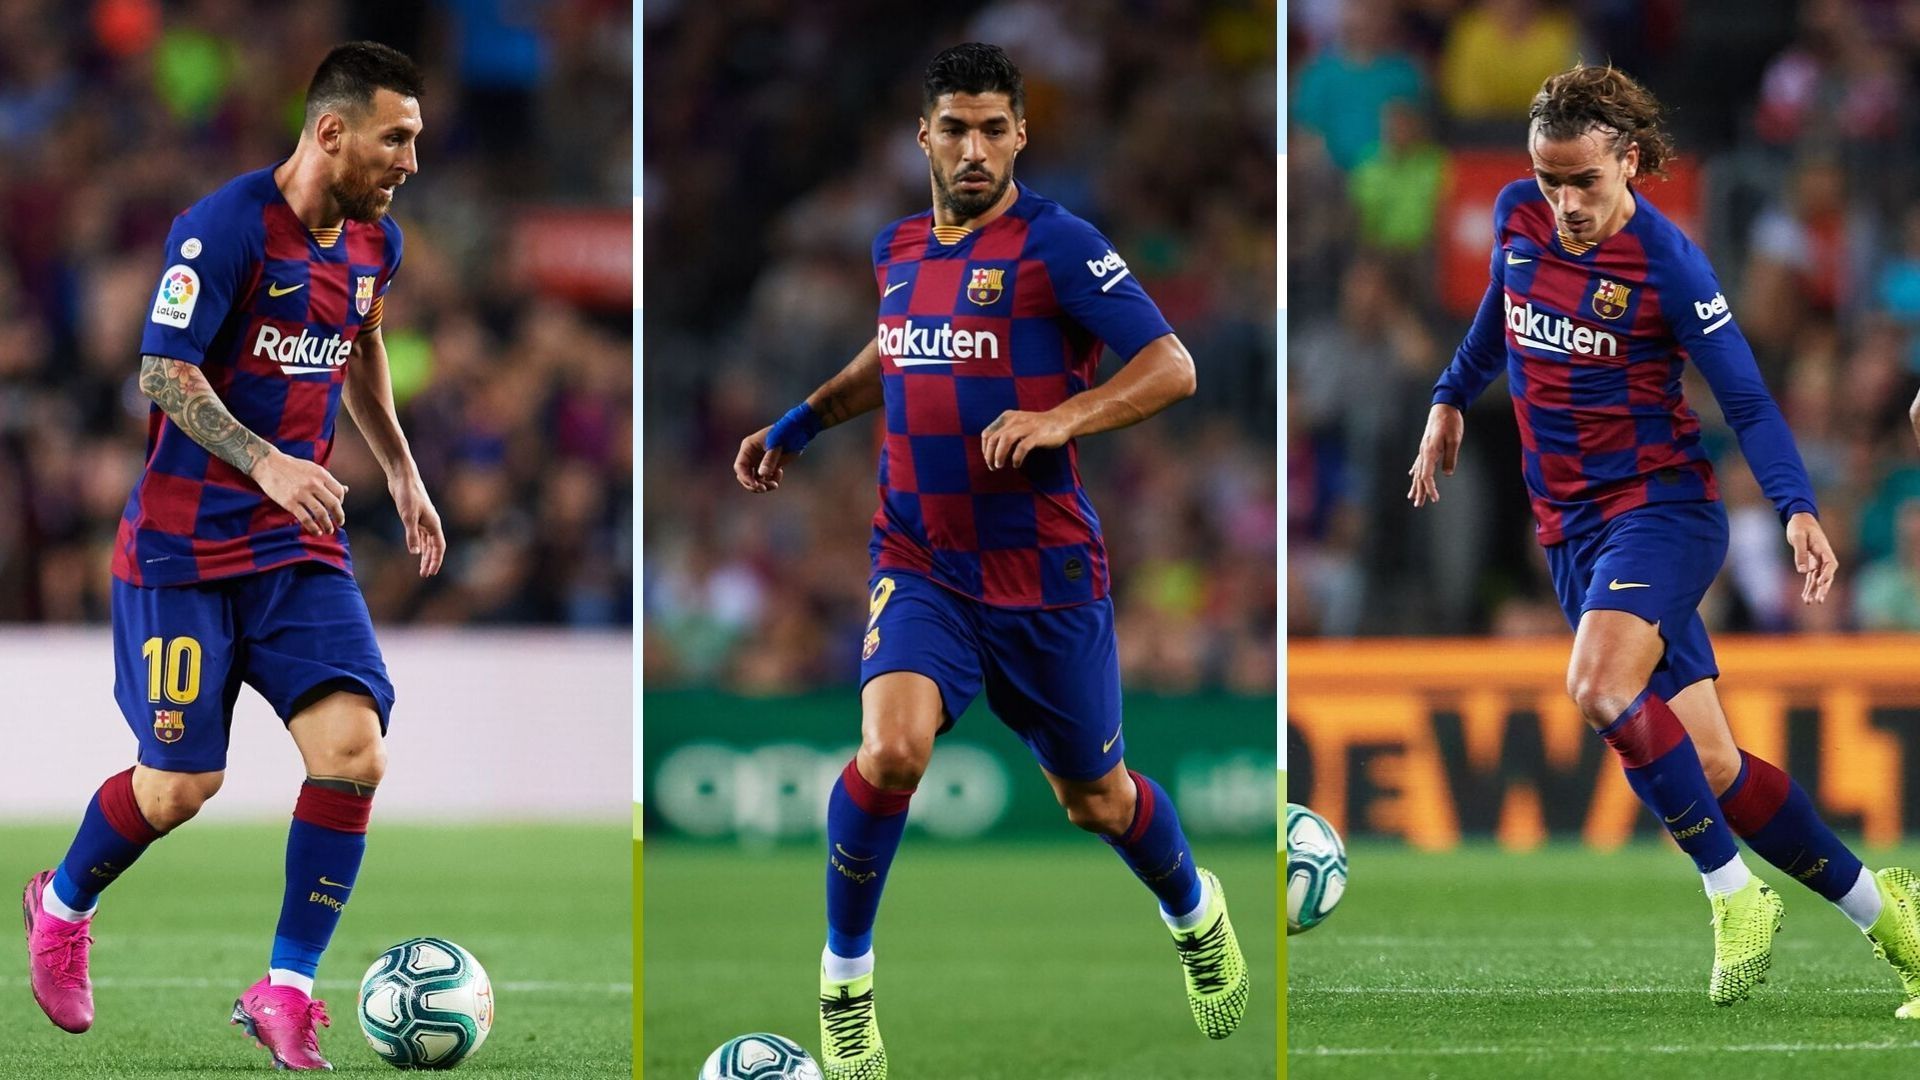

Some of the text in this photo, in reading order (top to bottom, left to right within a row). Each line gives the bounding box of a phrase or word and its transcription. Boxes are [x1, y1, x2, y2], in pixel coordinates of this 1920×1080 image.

[156, 305, 187, 320] LaLiga
[878, 319, 999, 359] Rakuten
[866, 577, 896, 634] 9
[142, 636, 202, 705] 10
